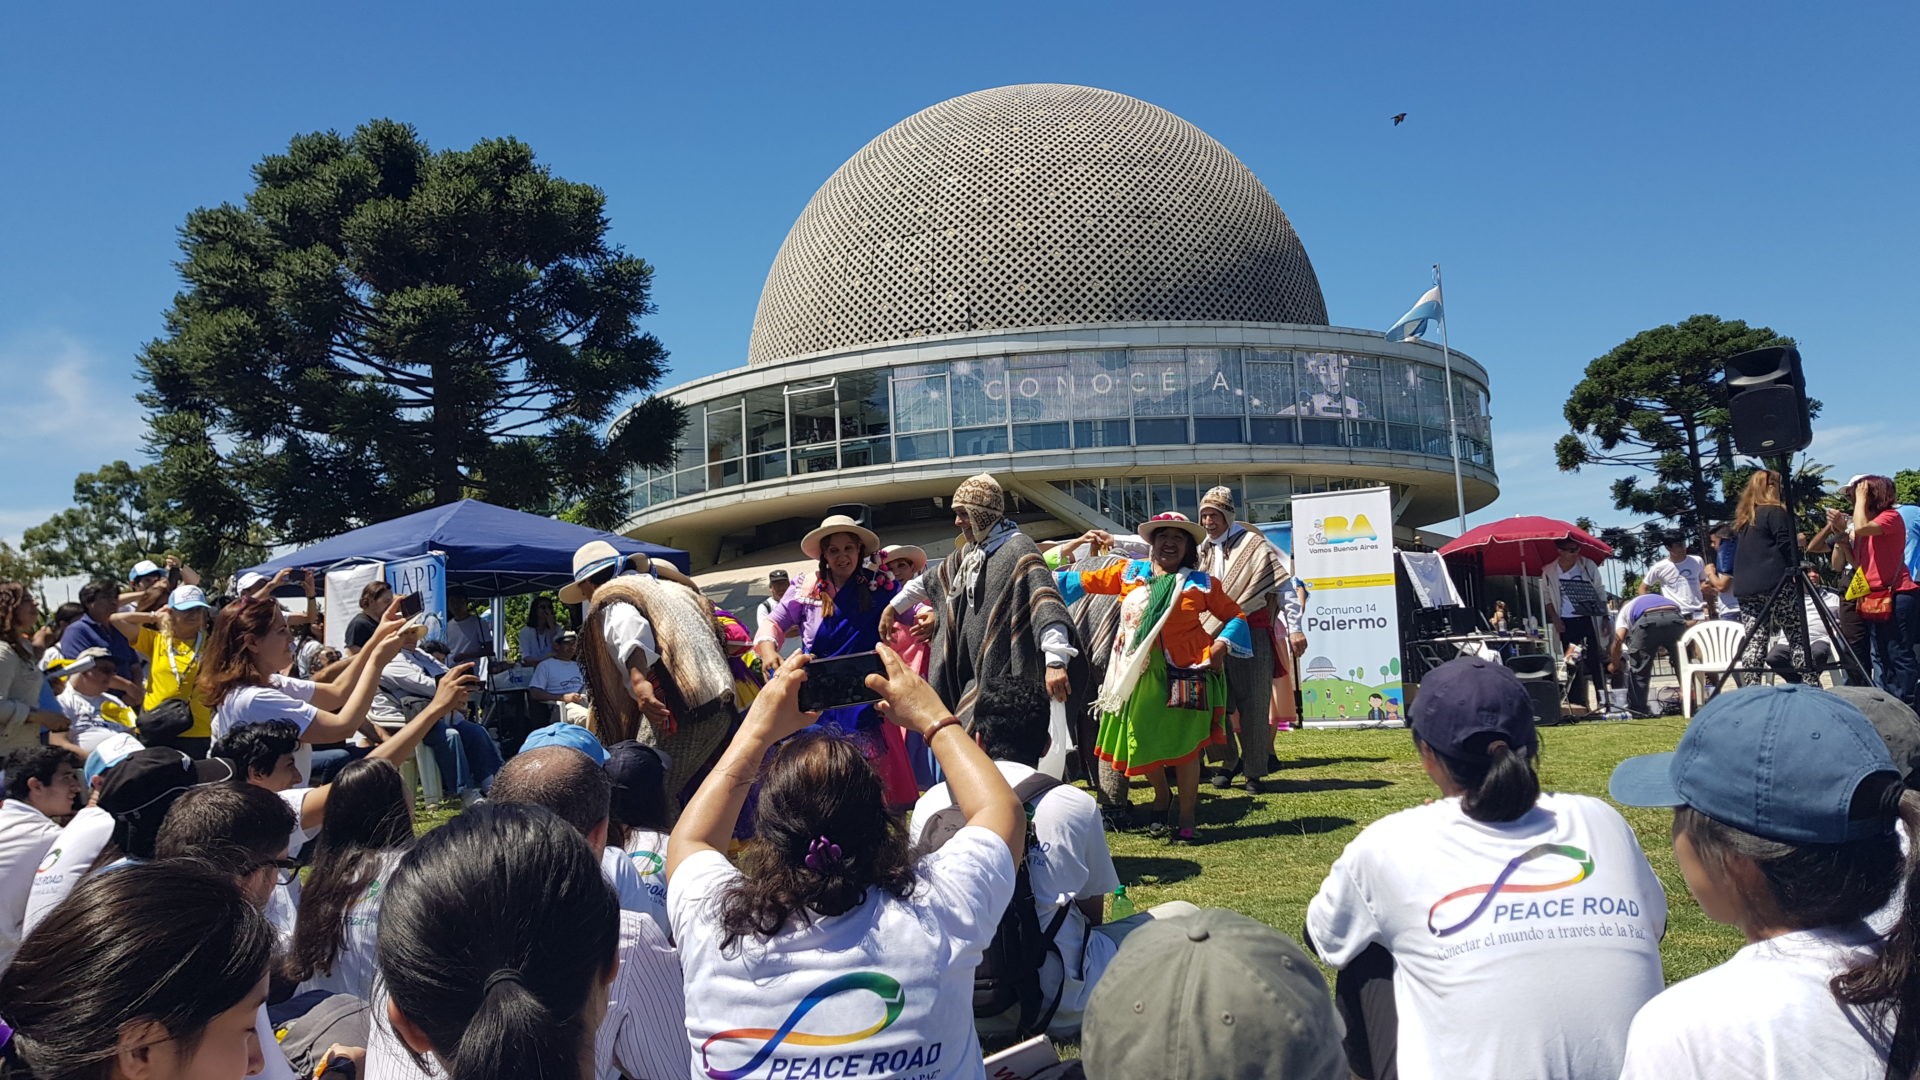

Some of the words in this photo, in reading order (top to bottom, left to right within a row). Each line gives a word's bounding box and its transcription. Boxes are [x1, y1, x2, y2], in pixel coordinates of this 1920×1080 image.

[984, 367, 1177, 400] CONOCÉ
[1212, 371, 1230, 391] A
[1309, 547, 1332, 555] Vamos
[1333, 545, 1359, 553] Buenos
[1360, 543, 1379, 551] Aires
[392, 563, 437, 595] IAPP
[1315, 605, 1362, 616] Comuna
[1365, 603, 1377, 613] 14
[1307, 615, 1388, 632] Palermo
[1493, 897, 1574, 924] PEACE
[1582, 896, 1640, 918] ROAD
[1498, 926, 1544, 945] mundo
[1547, 928, 1555, 939] a
[1560, 923, 1596, 939] través
[1598, 921, 1614, 937] de
[1614, 921, 1628, 937] la
[766, 1054, 864, 1080] PEACE
[868, 1041, 942, 1076] ROAD
